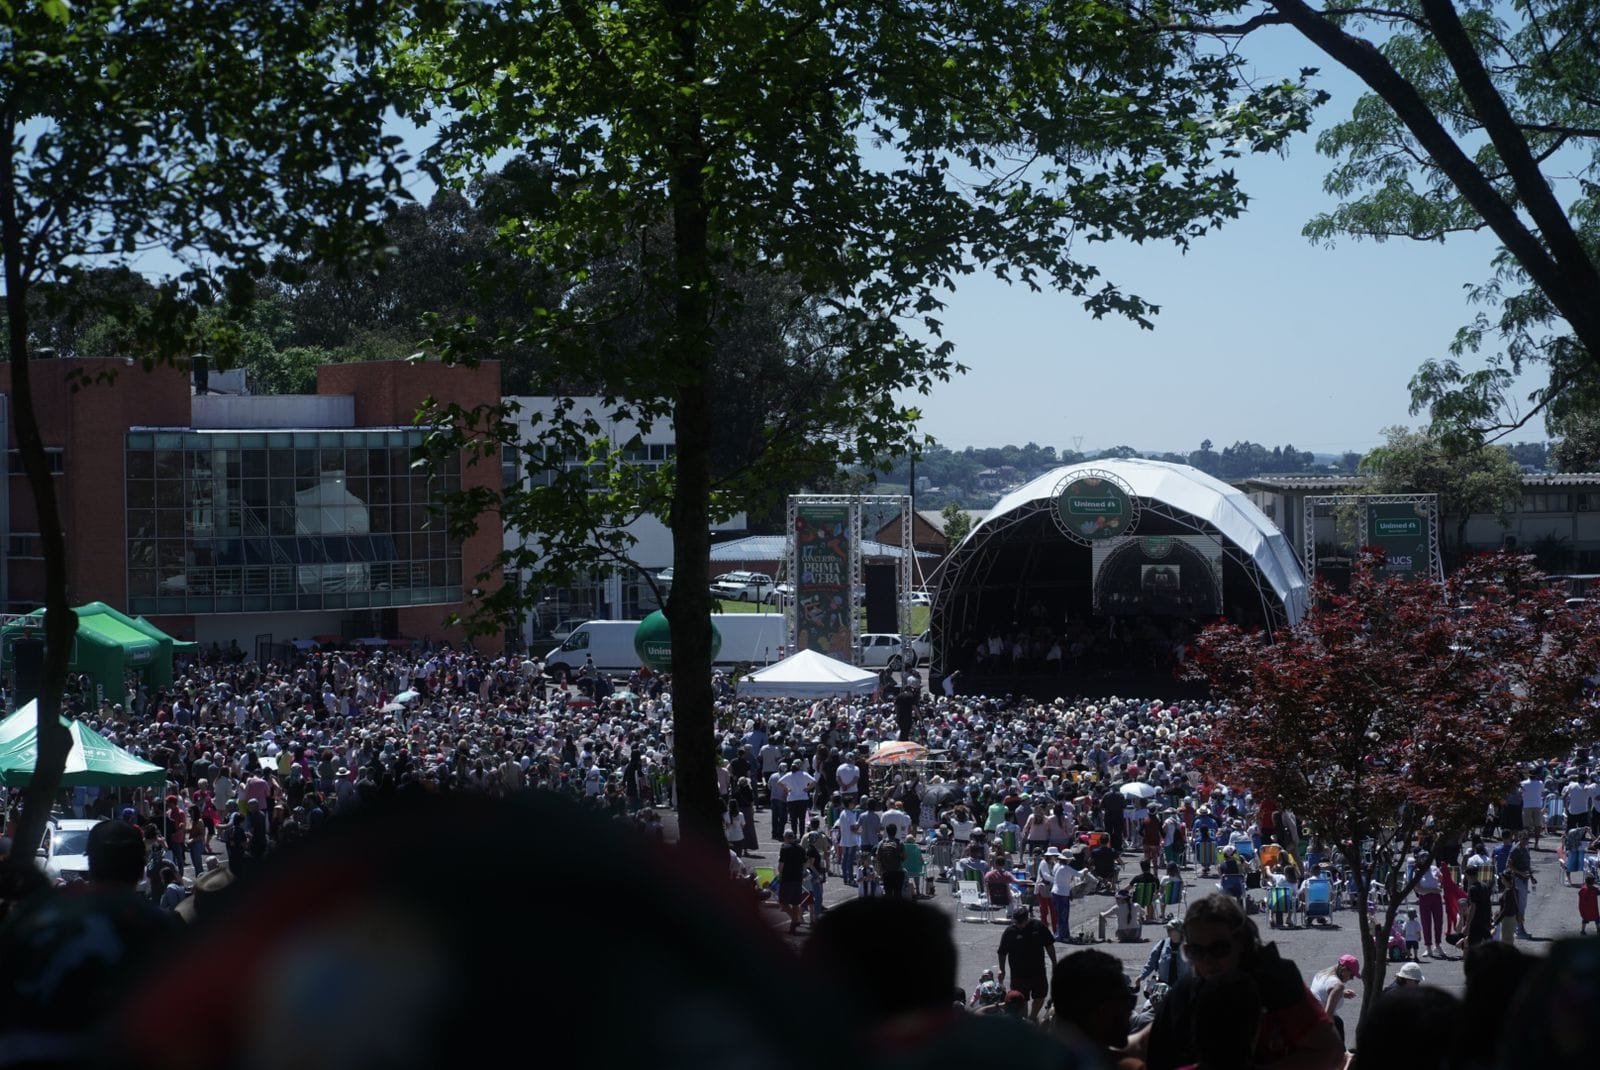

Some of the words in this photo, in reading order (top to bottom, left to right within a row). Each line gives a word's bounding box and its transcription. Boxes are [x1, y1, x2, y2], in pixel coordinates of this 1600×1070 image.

[1074, 500, 1106, 508] Unimed
[1392, 556, 1412, 565] UCS
[804, 562, 841, 574] PRIMA
[811, 573, 841, 585] VERA
[648, 647, 672, 655] Unim
